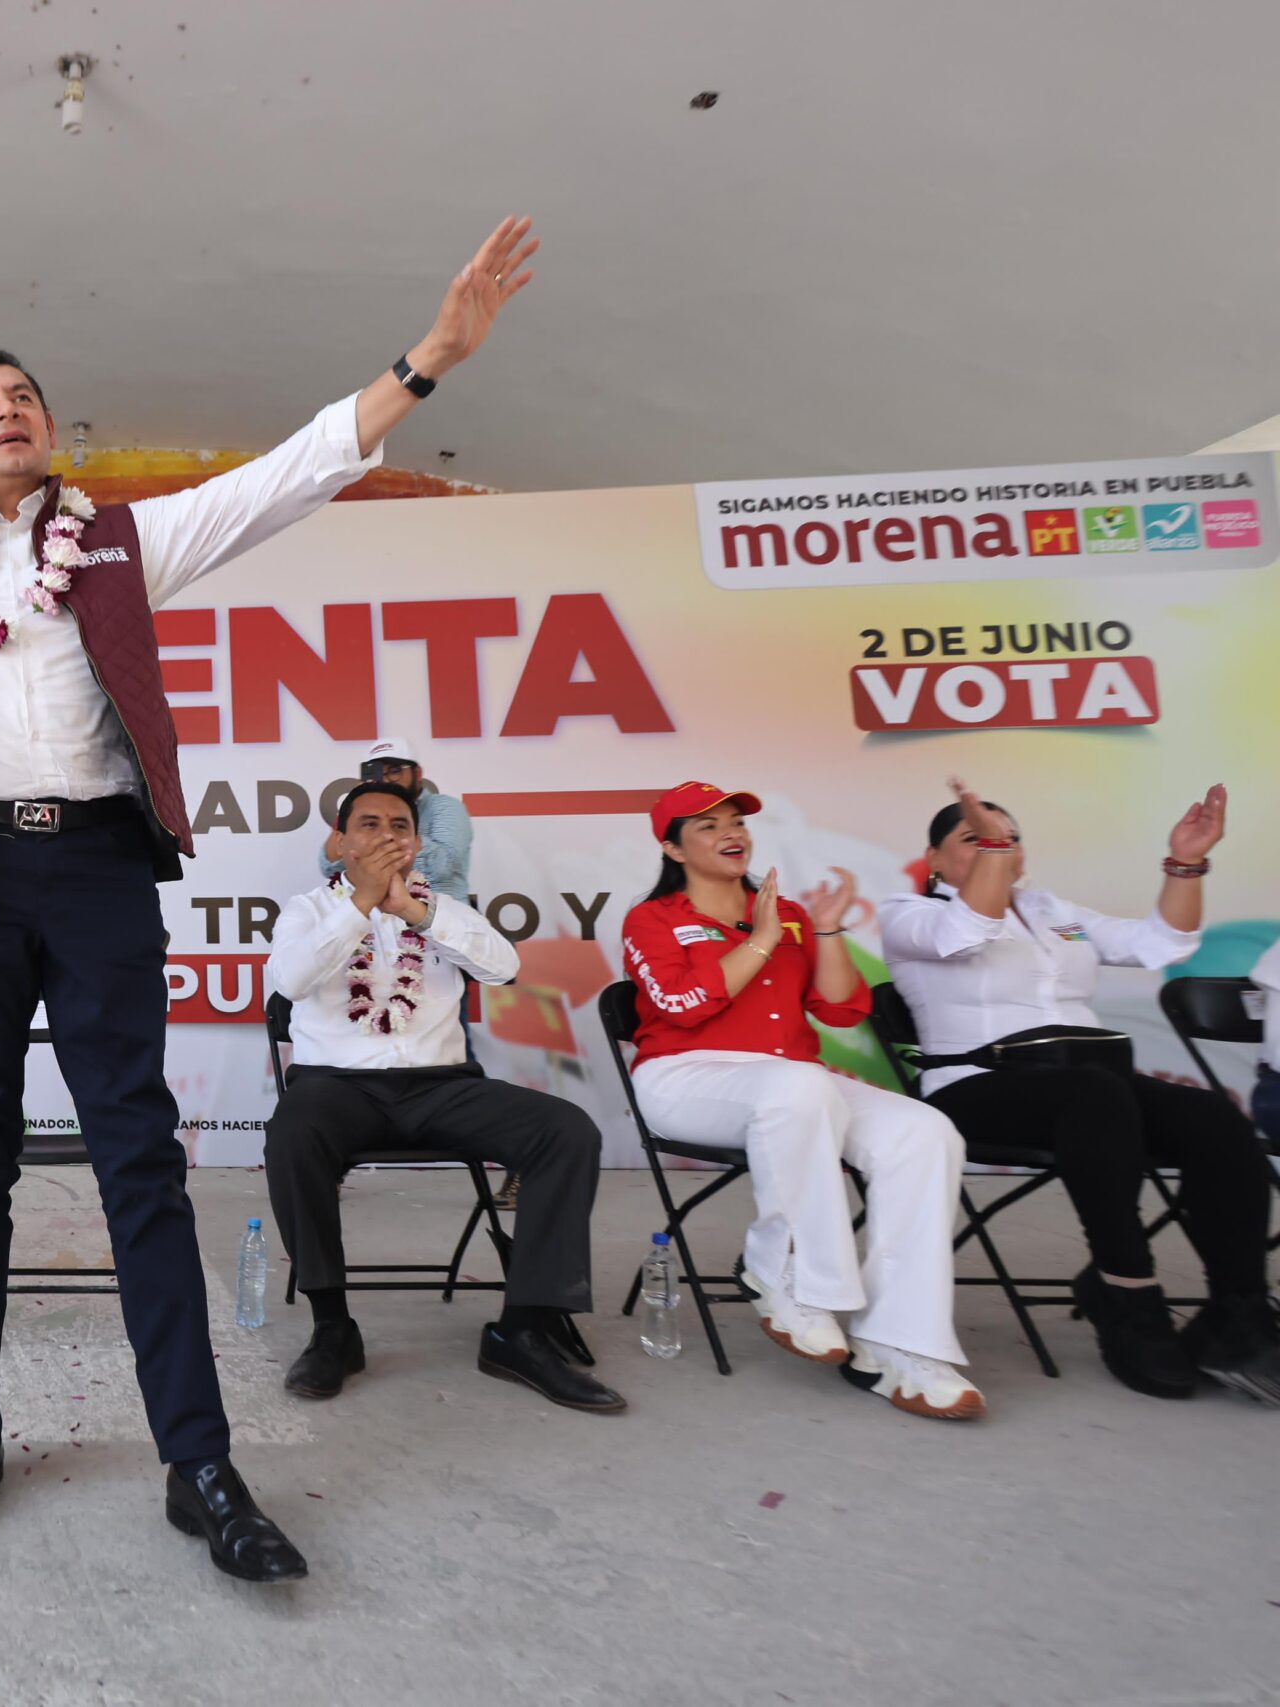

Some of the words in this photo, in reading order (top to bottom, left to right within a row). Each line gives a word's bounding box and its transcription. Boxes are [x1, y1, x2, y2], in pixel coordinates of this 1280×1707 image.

[718, 493, 829, 514] SIGAMOS
[836, 487, 968, 509] HACIENDO
[976, 480, 1097, 501] HISTORIA
[1105, 477, 1140, 495] EN
[1147, 471, 1253, 493] PUEBLA
[86, 549, 130, 566] orena
[720, 512, 1019, 568] morena
[1030, 526, 1076, 553] PT
[859, 628, 889, 658] 2
[902, 626, 968, 657] DE
[981, 620, 1132, 655] JUNIO
[855, 661, 1155, 724] VOTA
[559, 892, 612, 941] Y
[22, 1118, 79, 1130] RNADOR.
[175, 1120, 218, 1130] AMOS
[222, 1120, 265, 1131] HACIE
